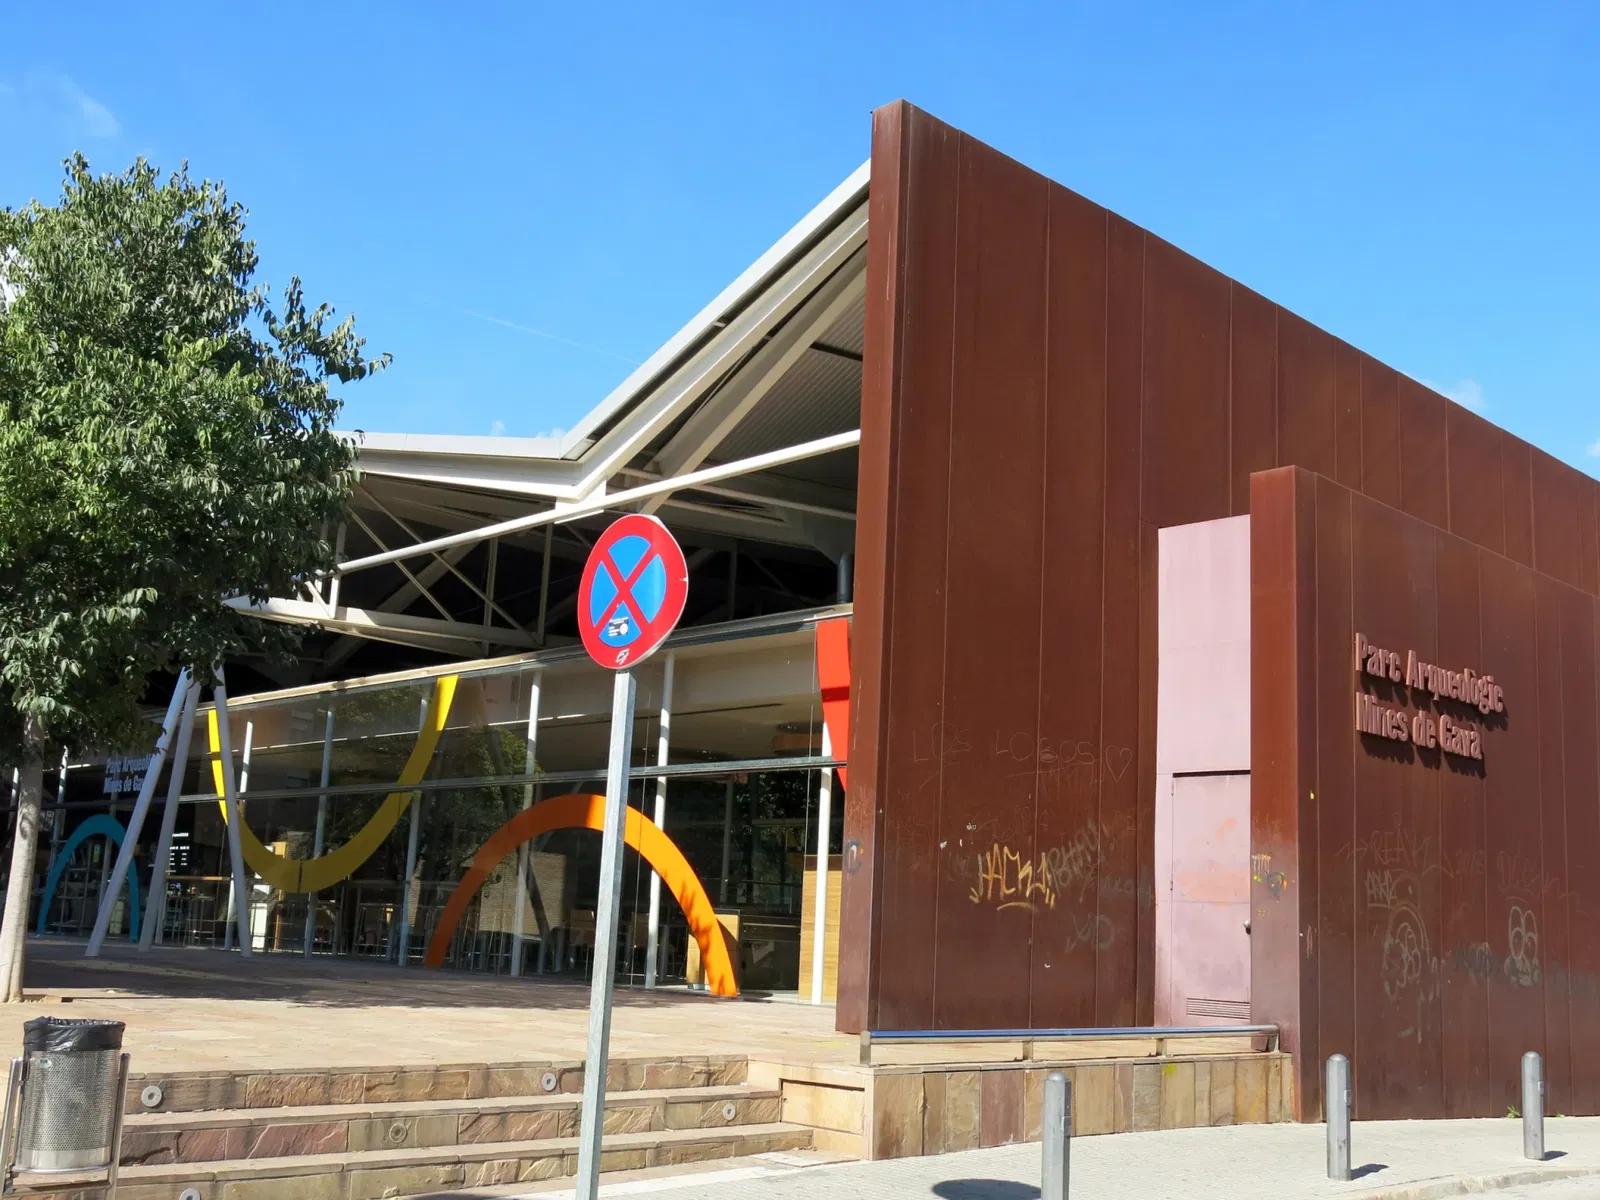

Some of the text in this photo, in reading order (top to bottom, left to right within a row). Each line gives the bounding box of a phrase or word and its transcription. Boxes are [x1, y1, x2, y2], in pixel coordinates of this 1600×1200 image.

[1355, 632, 1504, 715] Parc Arqueològic
[1355, 691, 1483, 760] Mines de Gavà
[106, 757, 121, 774] Parc
[123, 775, 131, 792] de
